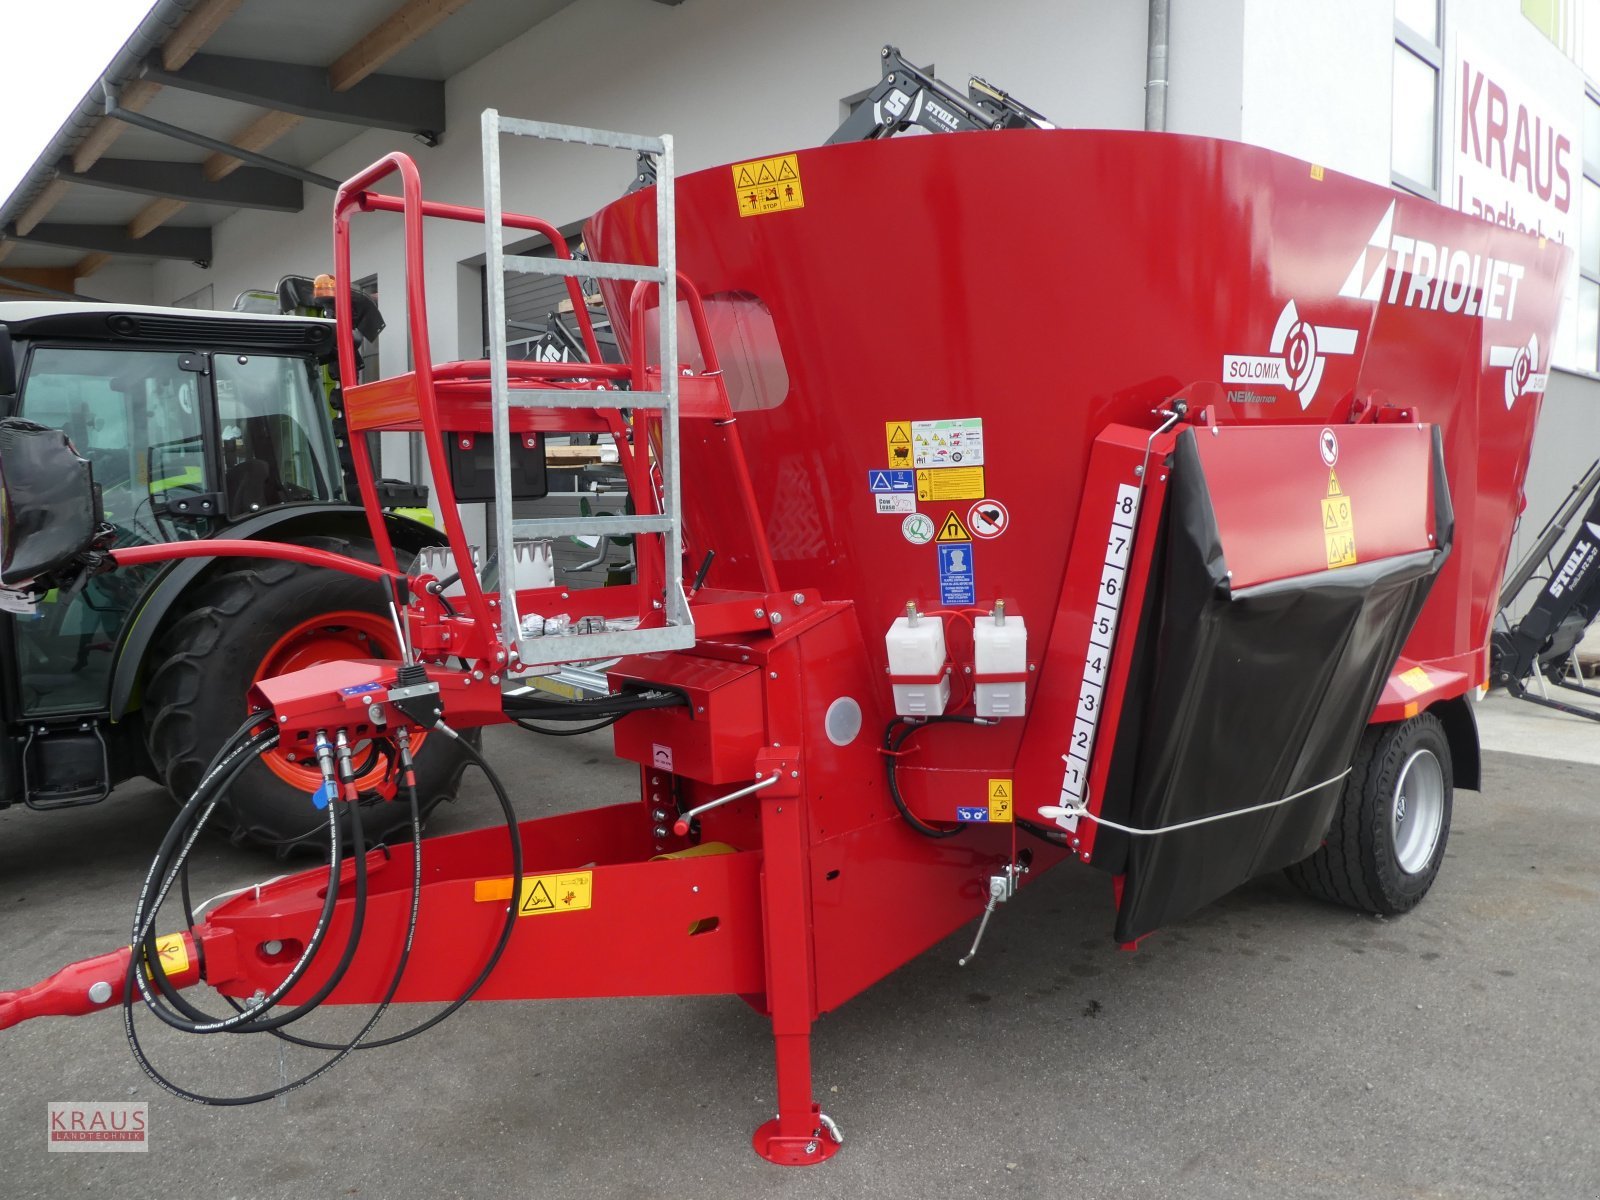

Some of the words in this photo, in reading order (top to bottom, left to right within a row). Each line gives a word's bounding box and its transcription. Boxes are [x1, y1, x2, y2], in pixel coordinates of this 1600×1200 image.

[925, 100, 960, 130] STOLL
[1461, 60, 1571, 214] KRAUS
[1387, 234, 1525, 321] TRIOLIET
[1229, 361, 1281, 379] SOLOMIX
[1121, 497, 1133, 514] 8
[1115, 537, 1126, 554] 7
[1549, 540, 1592, 599] STOLL
[1106, 578, 1117, 595] 6
[1098, 617, 1110, 634] 5
[1091, 657, 1102, 673] 4
[1084, 694, 1095, 711] 3
[1077, 731, 1088, 749] 2
[1072, 769, 1079, 783] 1
